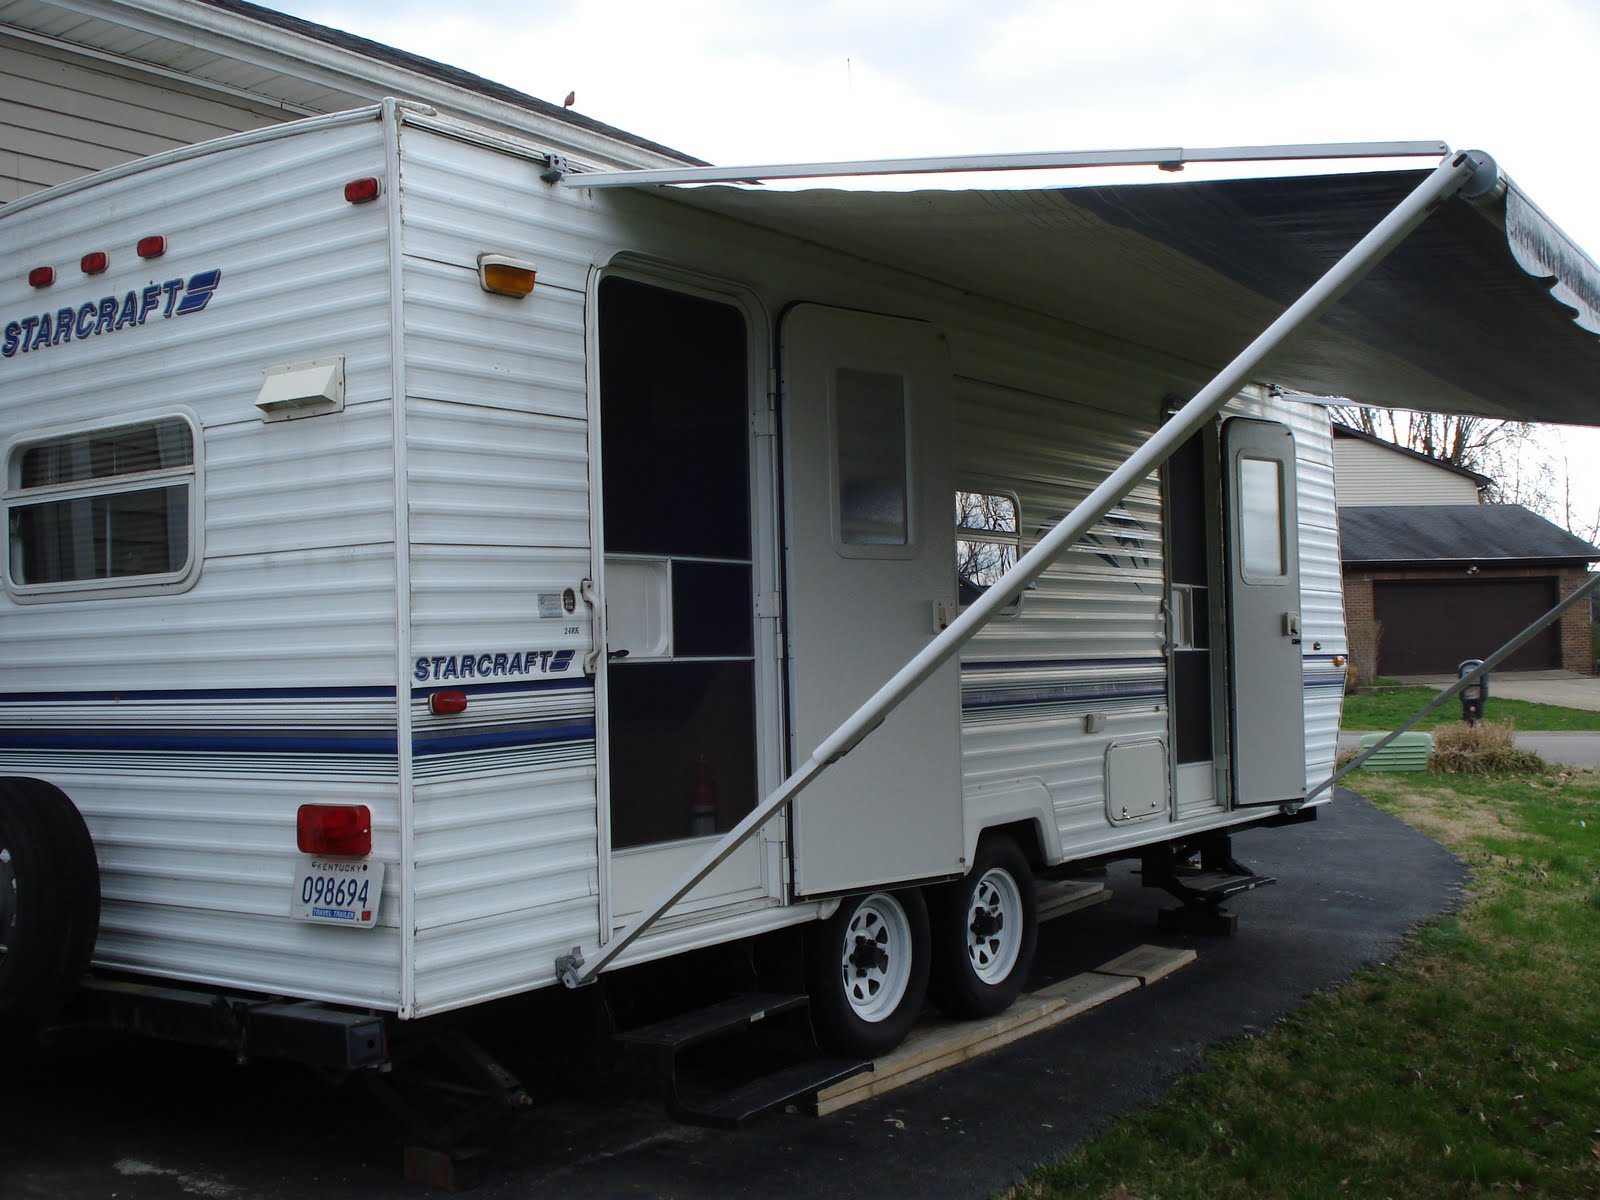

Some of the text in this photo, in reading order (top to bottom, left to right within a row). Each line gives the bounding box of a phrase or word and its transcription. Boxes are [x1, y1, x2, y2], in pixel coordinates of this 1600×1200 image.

[2, 278, 184, 358] STARCRAFT
[414, 651, 553, 681] STARCRAFT
[317, 863, 361, 872] KENTUCKY
[302, 876, 369, 908] 098694
[313, 908, 355, 919] TRAVEL TRAILER
